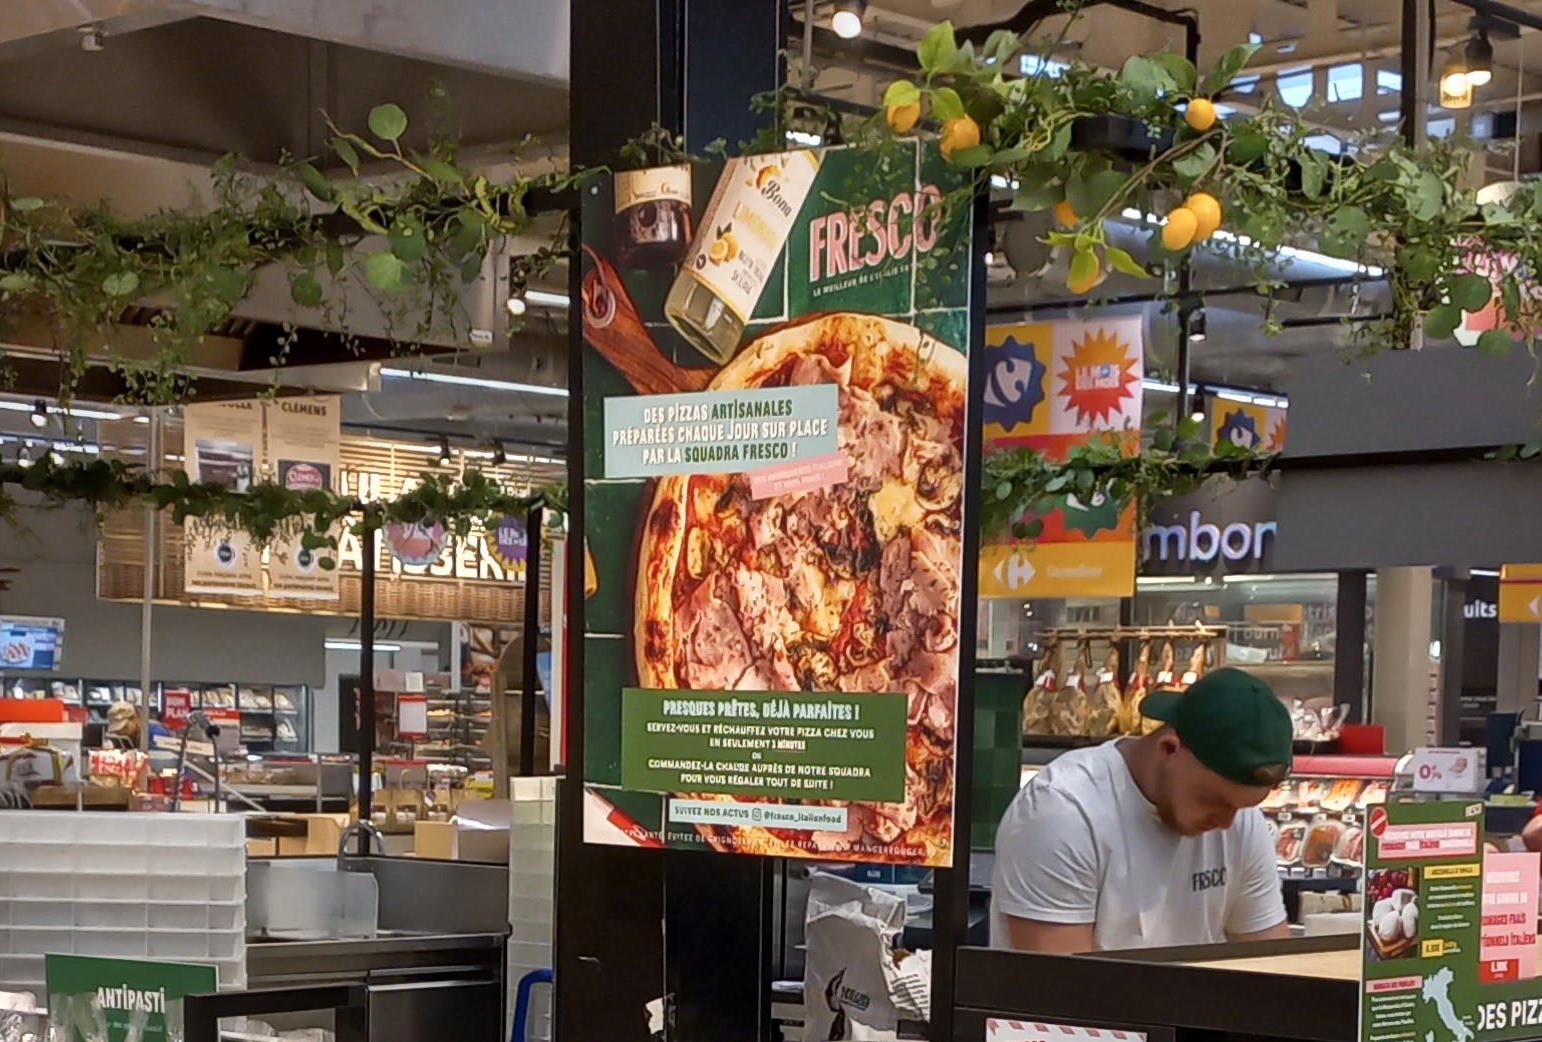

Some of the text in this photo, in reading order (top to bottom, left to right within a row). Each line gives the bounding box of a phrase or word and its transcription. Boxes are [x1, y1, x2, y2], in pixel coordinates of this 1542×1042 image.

[760, 179, 792, 218] Bona
[810, 184, 942, 282] FRESCO
[644, 399, 793, 423] DES PIZZAS ARTISANALES
[613, 418, 828, 446] PRÉPARÉES CHAQUE JOUR SUR PLACE
[643, 441, 788, 465] PAR LA SQUADRA FRESCO
[663, 700, 715, 717] PRESQUES
[762, 700, 790, 719] DÉJÀ
[792, 700, 852, 721] PARFAITES
[647, 722, 700, 735] SERVEZ-VOUS
[713, 723, 766, 737] RÉCHAUFFEZ
[768, 726, 795, 737] VOTRE
[797, 727, 822, 738] PIZZA
[824, 727, 847, 738] CHEZ
[850, 728, 874, 739] VOUS
[723, 738, 770, 749] SEULEMENT
[648, 758, 714, 772] COMMANDEZ-LA
[752, 761, 783, 774] AUPRÈS
[797, 765, 826, 776] NOTRE
[828, 766, 871, 778] SQUADRA
[680, 773, 702, 784] POUR
[704, 775, 726, 785] VOUS
[728, 774, 763, 787] RÉGALER
[765, 777, 788, 788] TOUT
[674, 805, 701, 816] SUIVEZ
[704, 806, 721, 817] NOS
[723, 807, 749, 818] ACTUS
[97, 984, 166, 1013] ANTIPASTI
